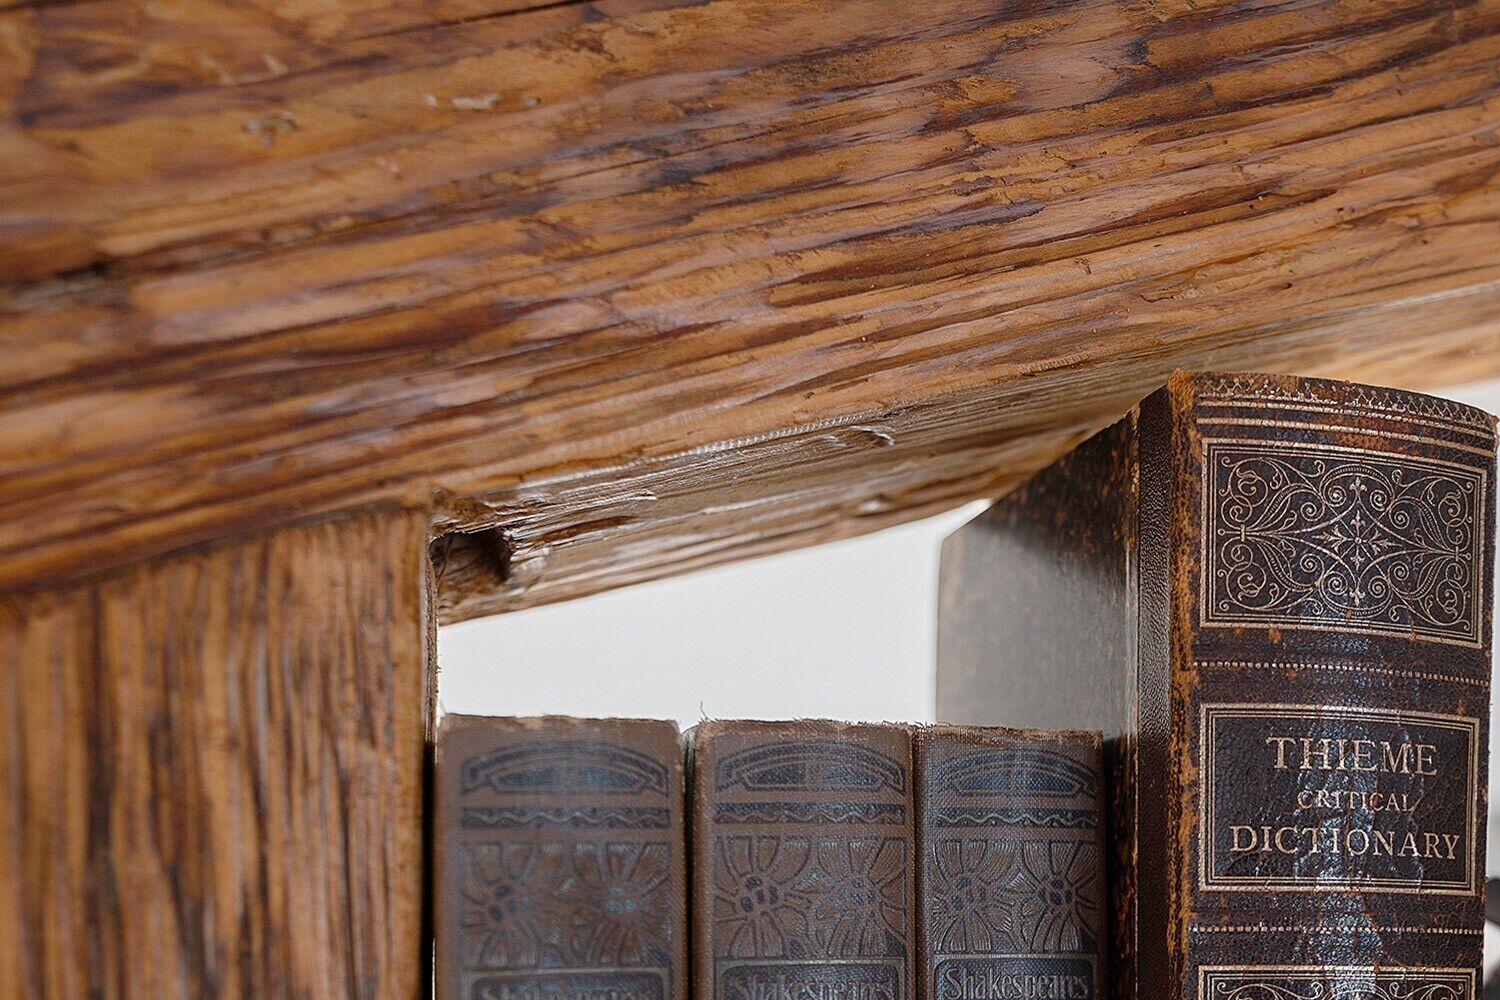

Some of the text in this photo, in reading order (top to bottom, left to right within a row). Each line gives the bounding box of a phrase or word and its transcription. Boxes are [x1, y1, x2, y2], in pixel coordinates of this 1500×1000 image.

[1265, 736, 1438, 776] THIEME
[1297, 790, 1416, 812] CRITICAL
[1229, 825, 1460, 860] DICTIONARY
[941, 967, 1090, 1000] Shakespeares
